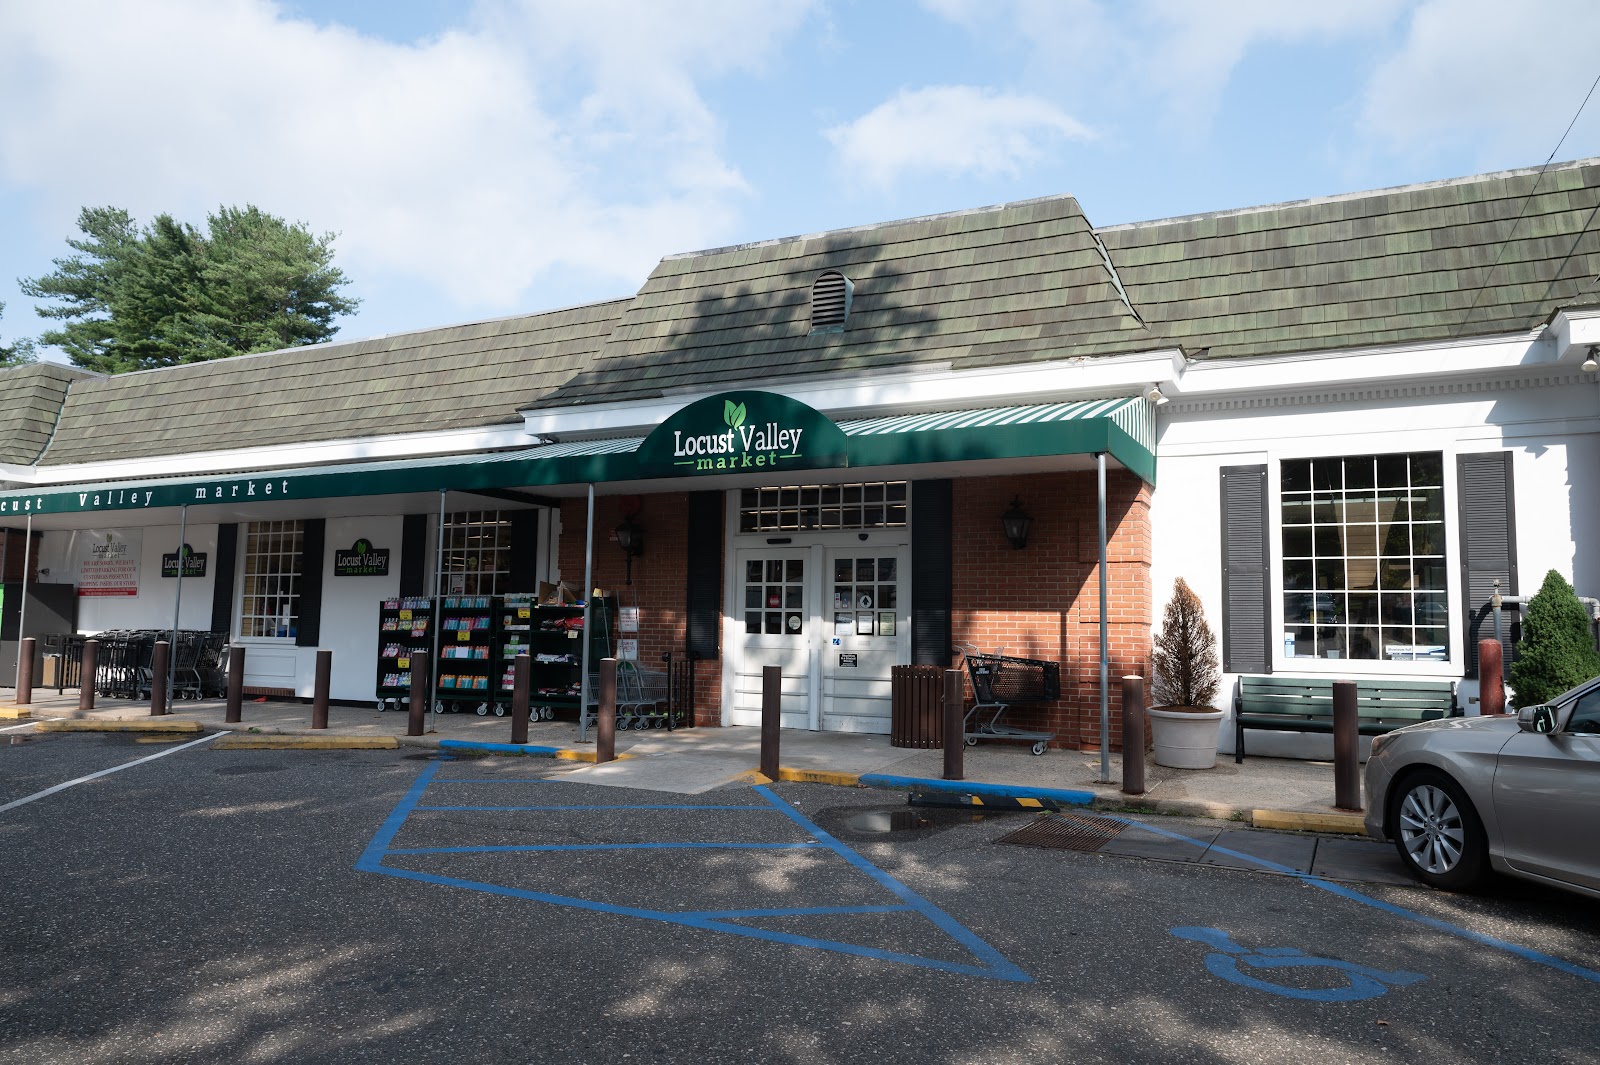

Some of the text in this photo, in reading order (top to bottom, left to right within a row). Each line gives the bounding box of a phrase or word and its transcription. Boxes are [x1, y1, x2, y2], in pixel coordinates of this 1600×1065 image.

[673, 422, 803, 457] Locust Valley
[696, 451, 777, 470] market
[79, 490, 153, 507] Valley
[195, 480, 288, 498] market
[92, 542, 127, 554] Locust Valley
[185, 557, 204, 570] Valley
[338, 553, 386, 568] Locust Valley
